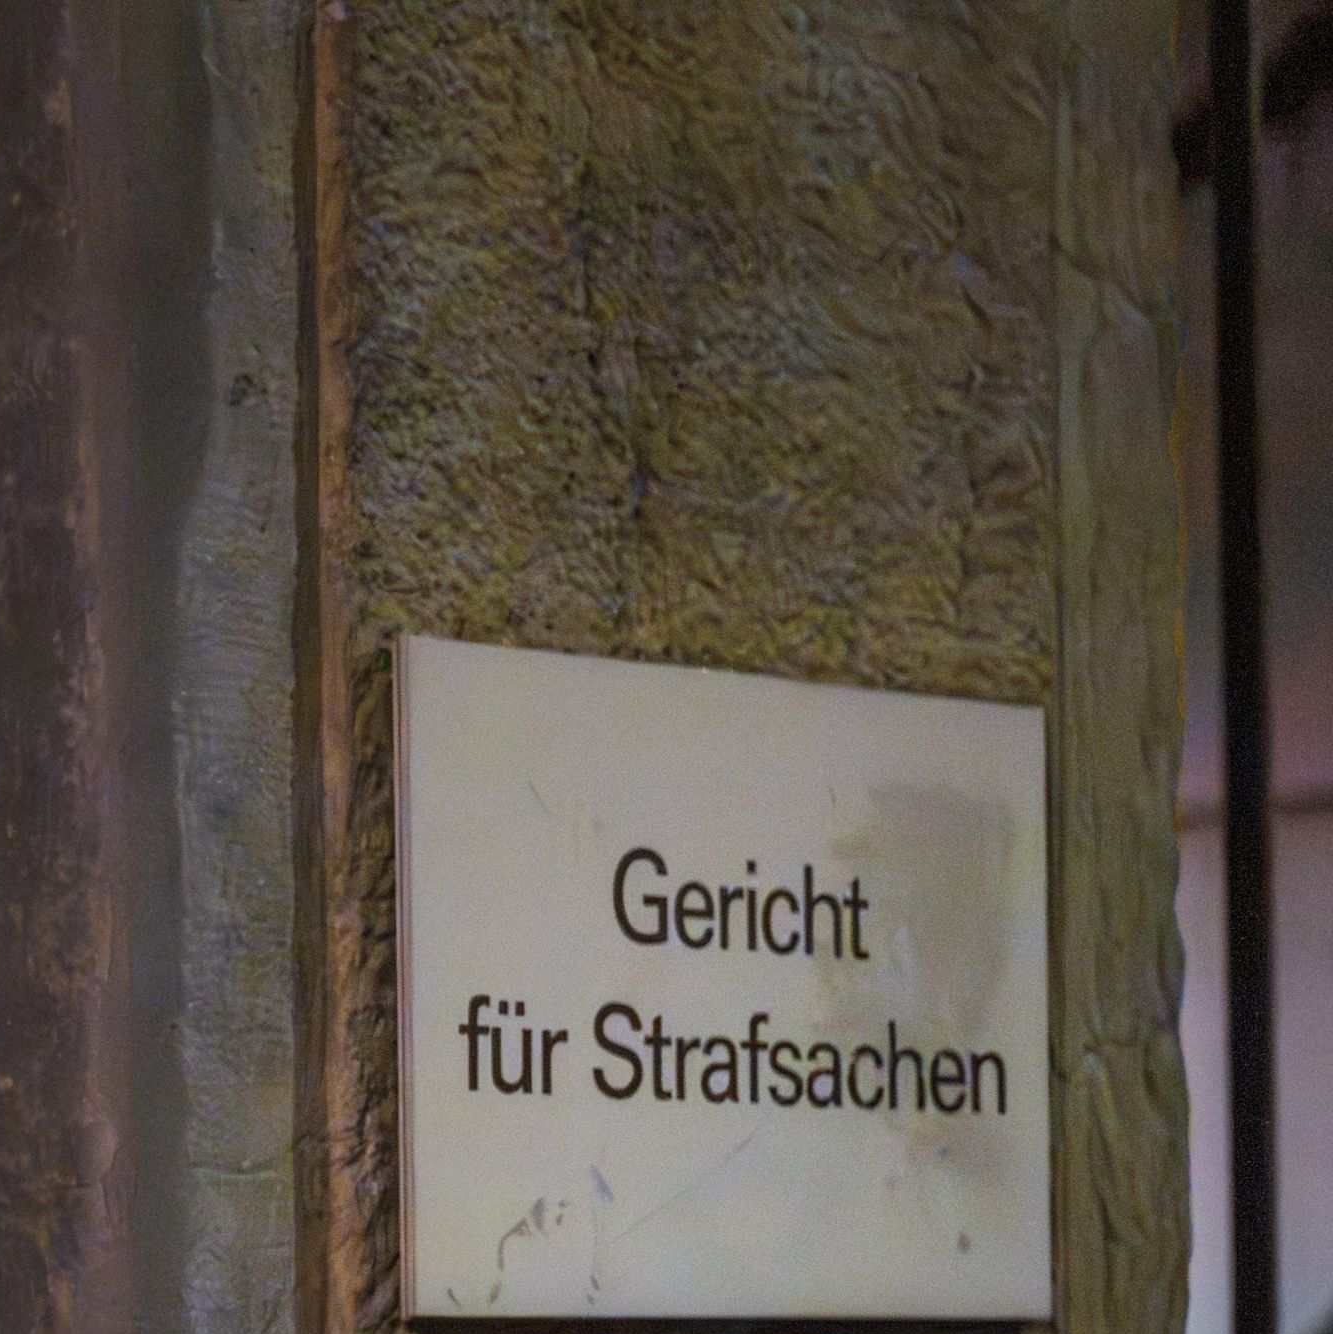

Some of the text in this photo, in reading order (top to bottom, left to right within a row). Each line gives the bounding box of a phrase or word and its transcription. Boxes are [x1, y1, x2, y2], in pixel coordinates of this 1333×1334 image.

[612, 846, 870, 960] Gericht
[458, 994, 1008, 1116] für Strafsachen
